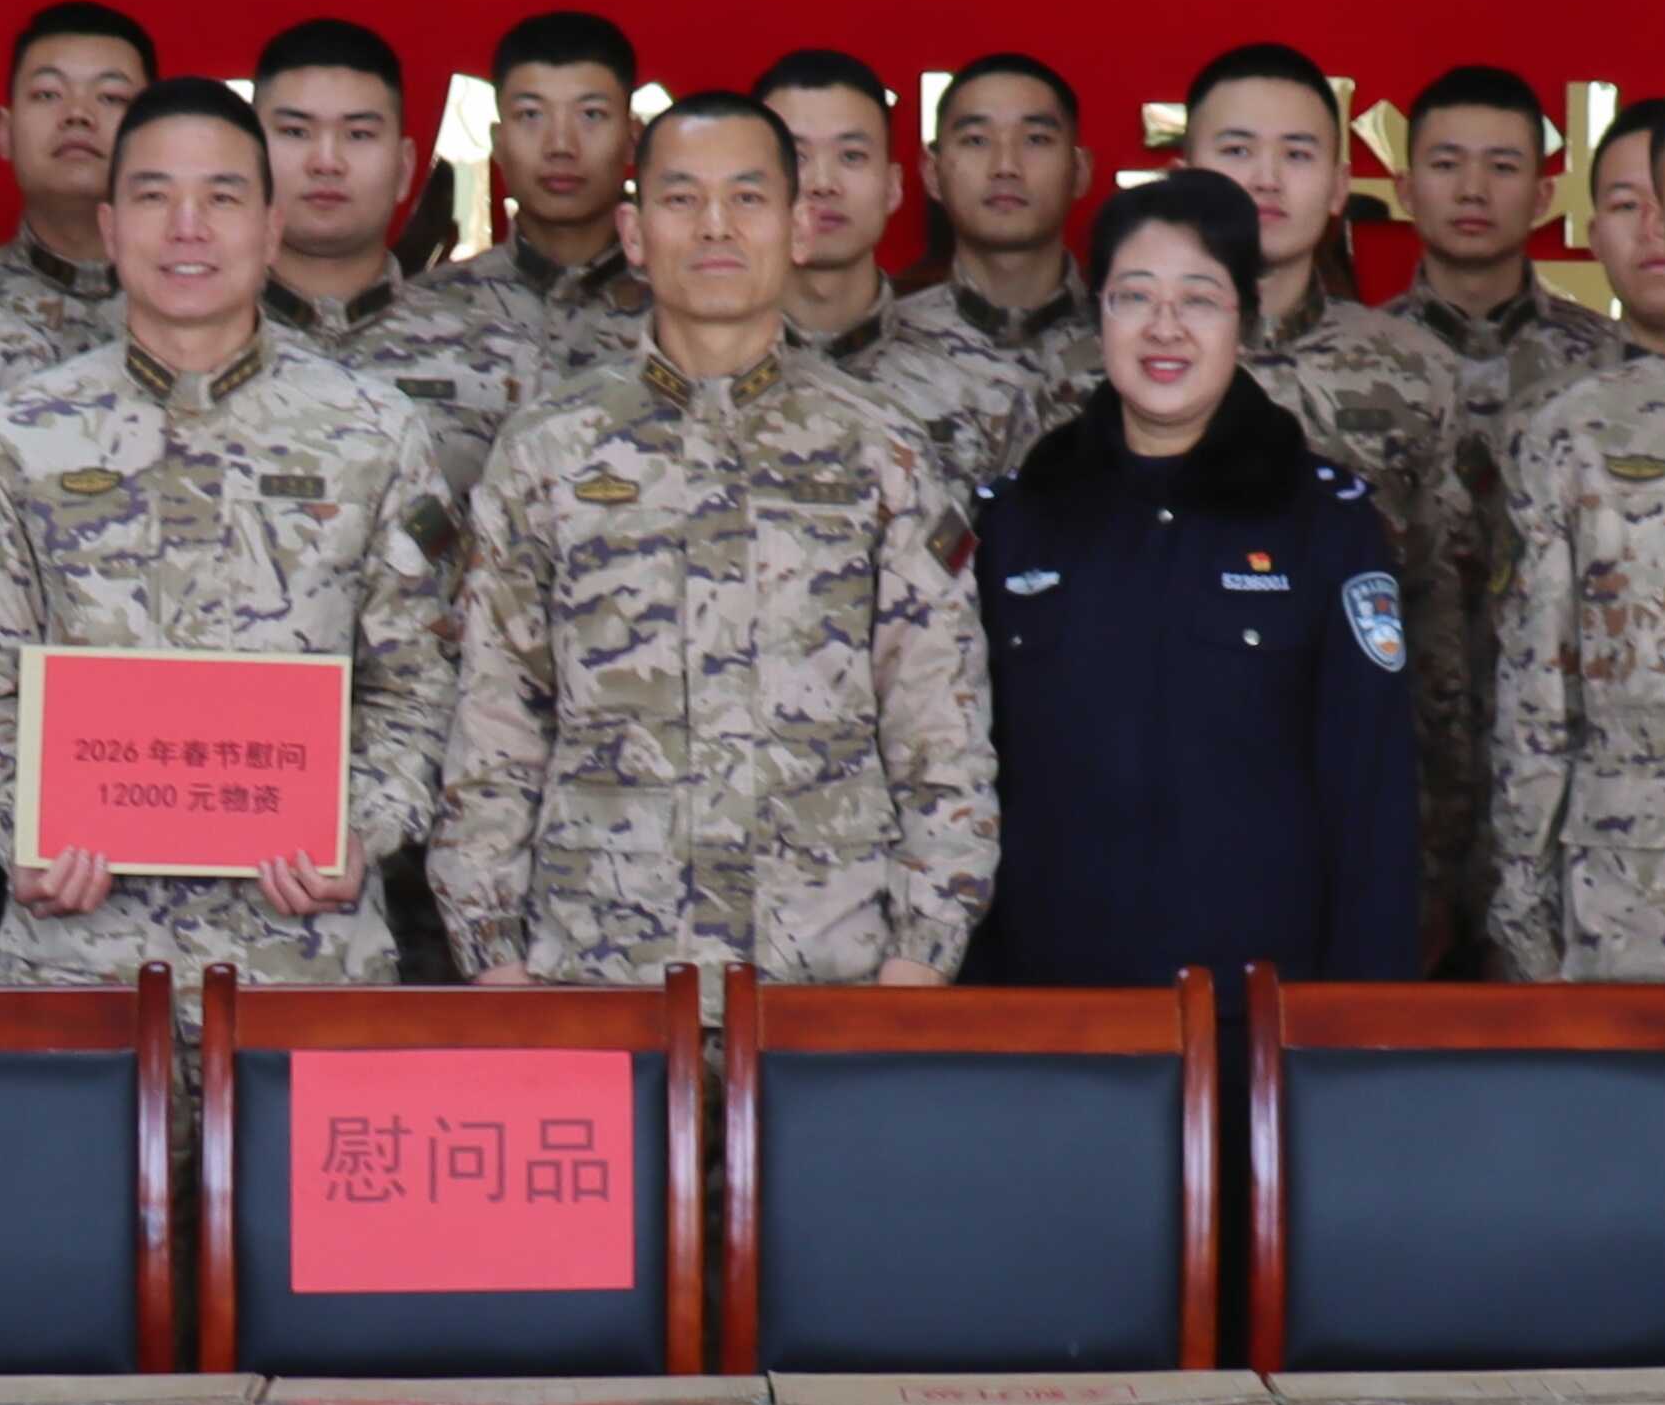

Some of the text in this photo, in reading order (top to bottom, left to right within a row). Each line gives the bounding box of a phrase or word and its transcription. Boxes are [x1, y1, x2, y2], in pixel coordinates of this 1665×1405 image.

[74, 739, 139, 763] 2026
[99, 782, 282, 814] 12000 元物资
[322, 1115, 609, 1203] 慰问品
